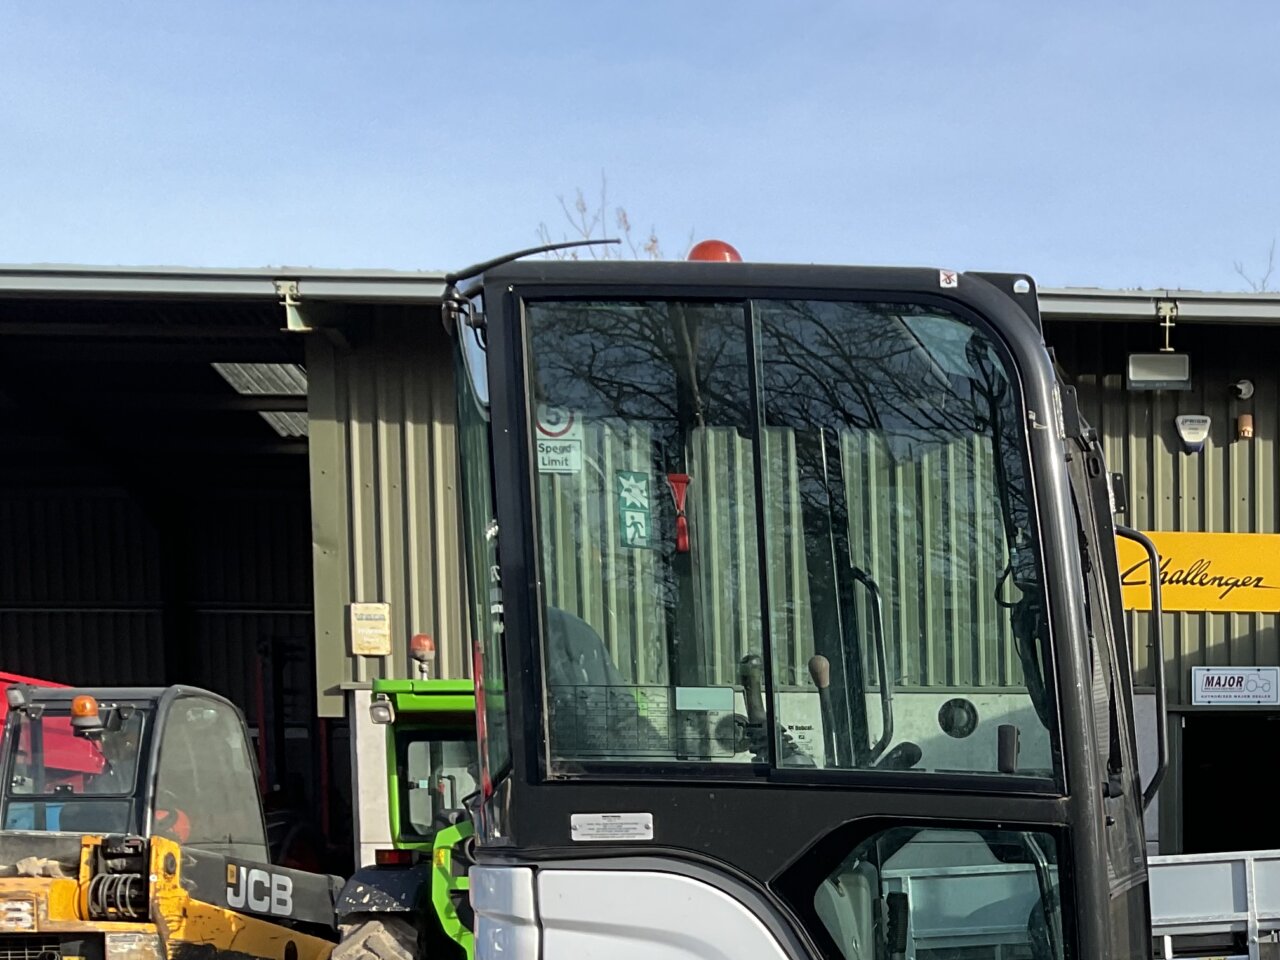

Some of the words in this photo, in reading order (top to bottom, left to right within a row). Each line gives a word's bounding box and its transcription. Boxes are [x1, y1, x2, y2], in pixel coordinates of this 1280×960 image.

[546, 407, 561, 426] 5
[541, 457, 569, 466] Limit
[1205, 676, 1244, 687] MAJOR
[226, 866, 293, 916] JCB
